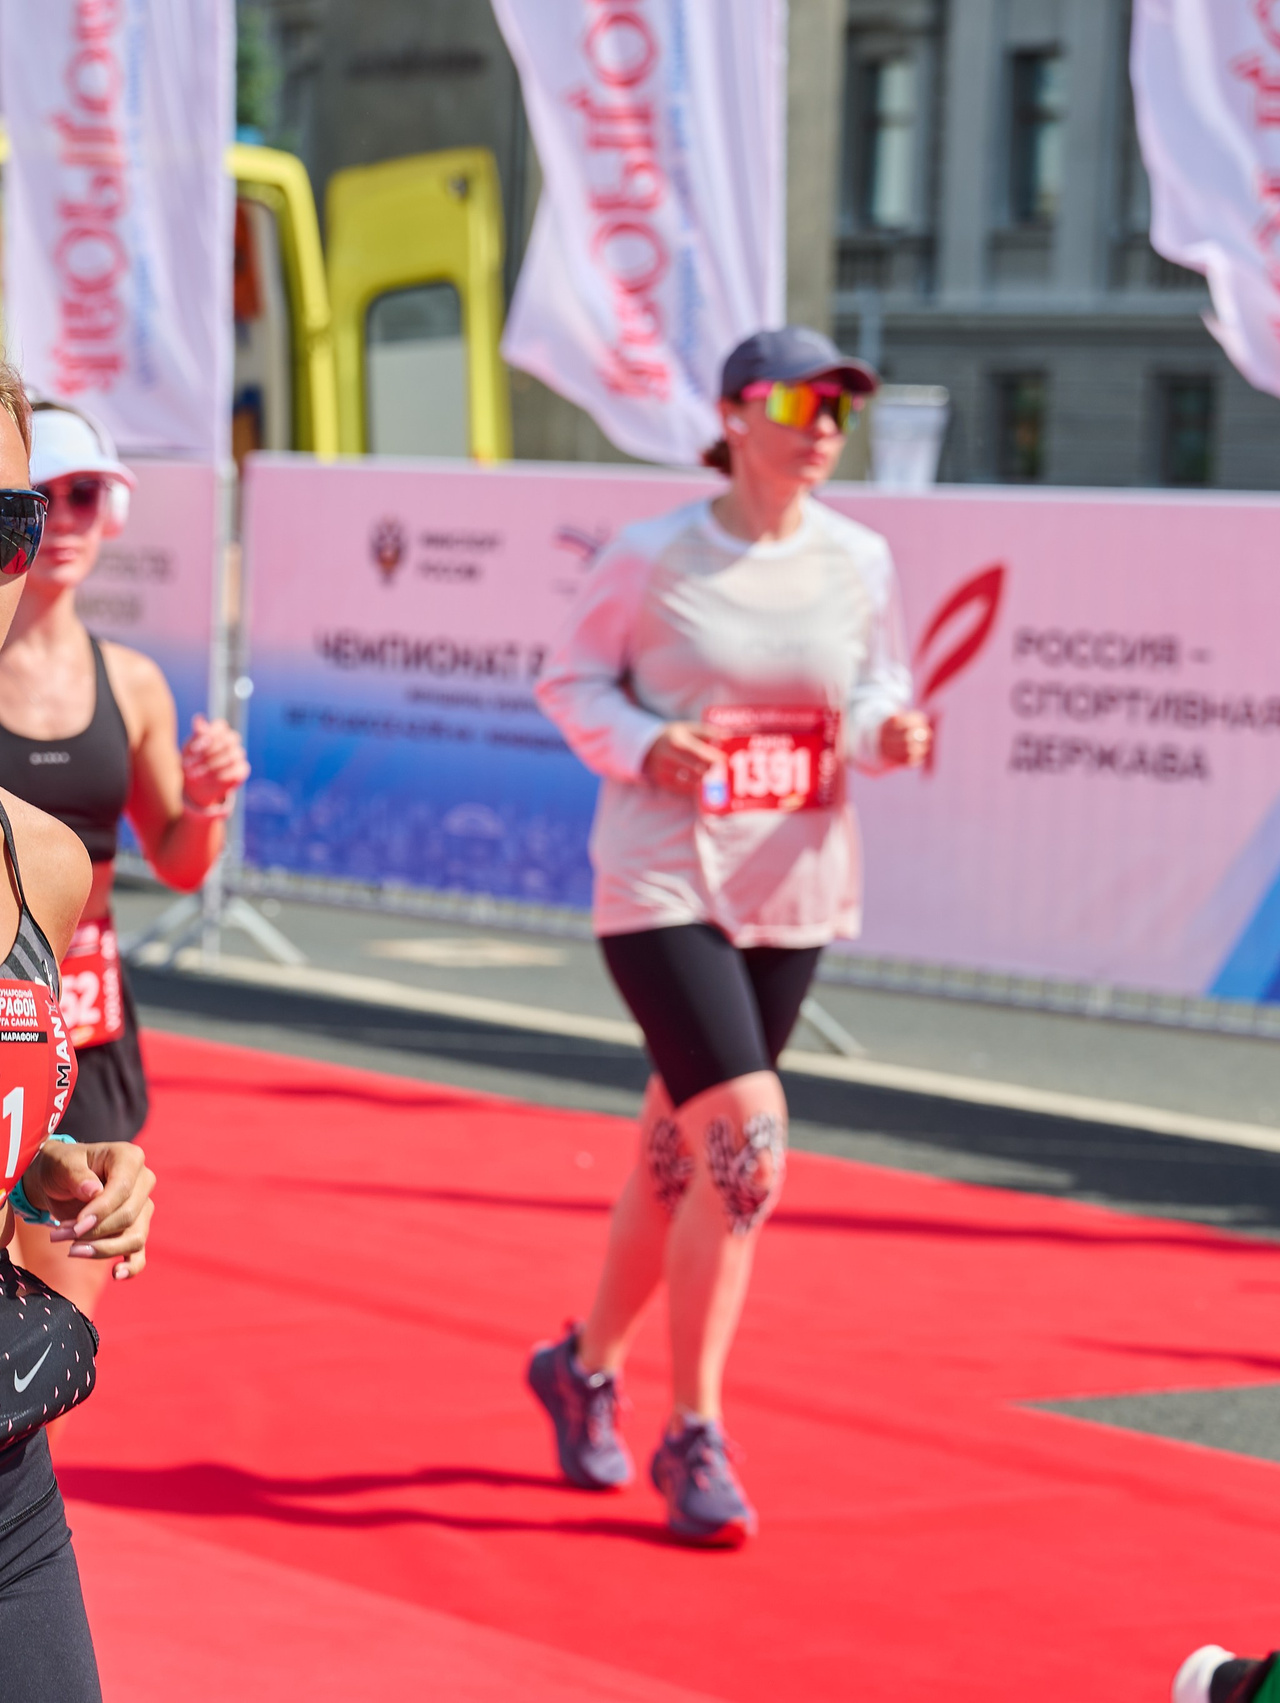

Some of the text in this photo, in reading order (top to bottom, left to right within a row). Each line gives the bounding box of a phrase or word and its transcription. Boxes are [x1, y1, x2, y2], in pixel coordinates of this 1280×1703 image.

[317, 630, 520, 679] ЧЕМПИОНАТ
[1014, 629, 1179, 669] РОССИЯ
[730, 747, 811, 797] 1391
[1010, 733, 1210, 782] ДЕРЖАВА
[1, 1032, 40, 1043] МАРАФОНУ
[11, 1018, 39, 1028] САМАРА
[42, 1016, 71, 1148] GAMAN
